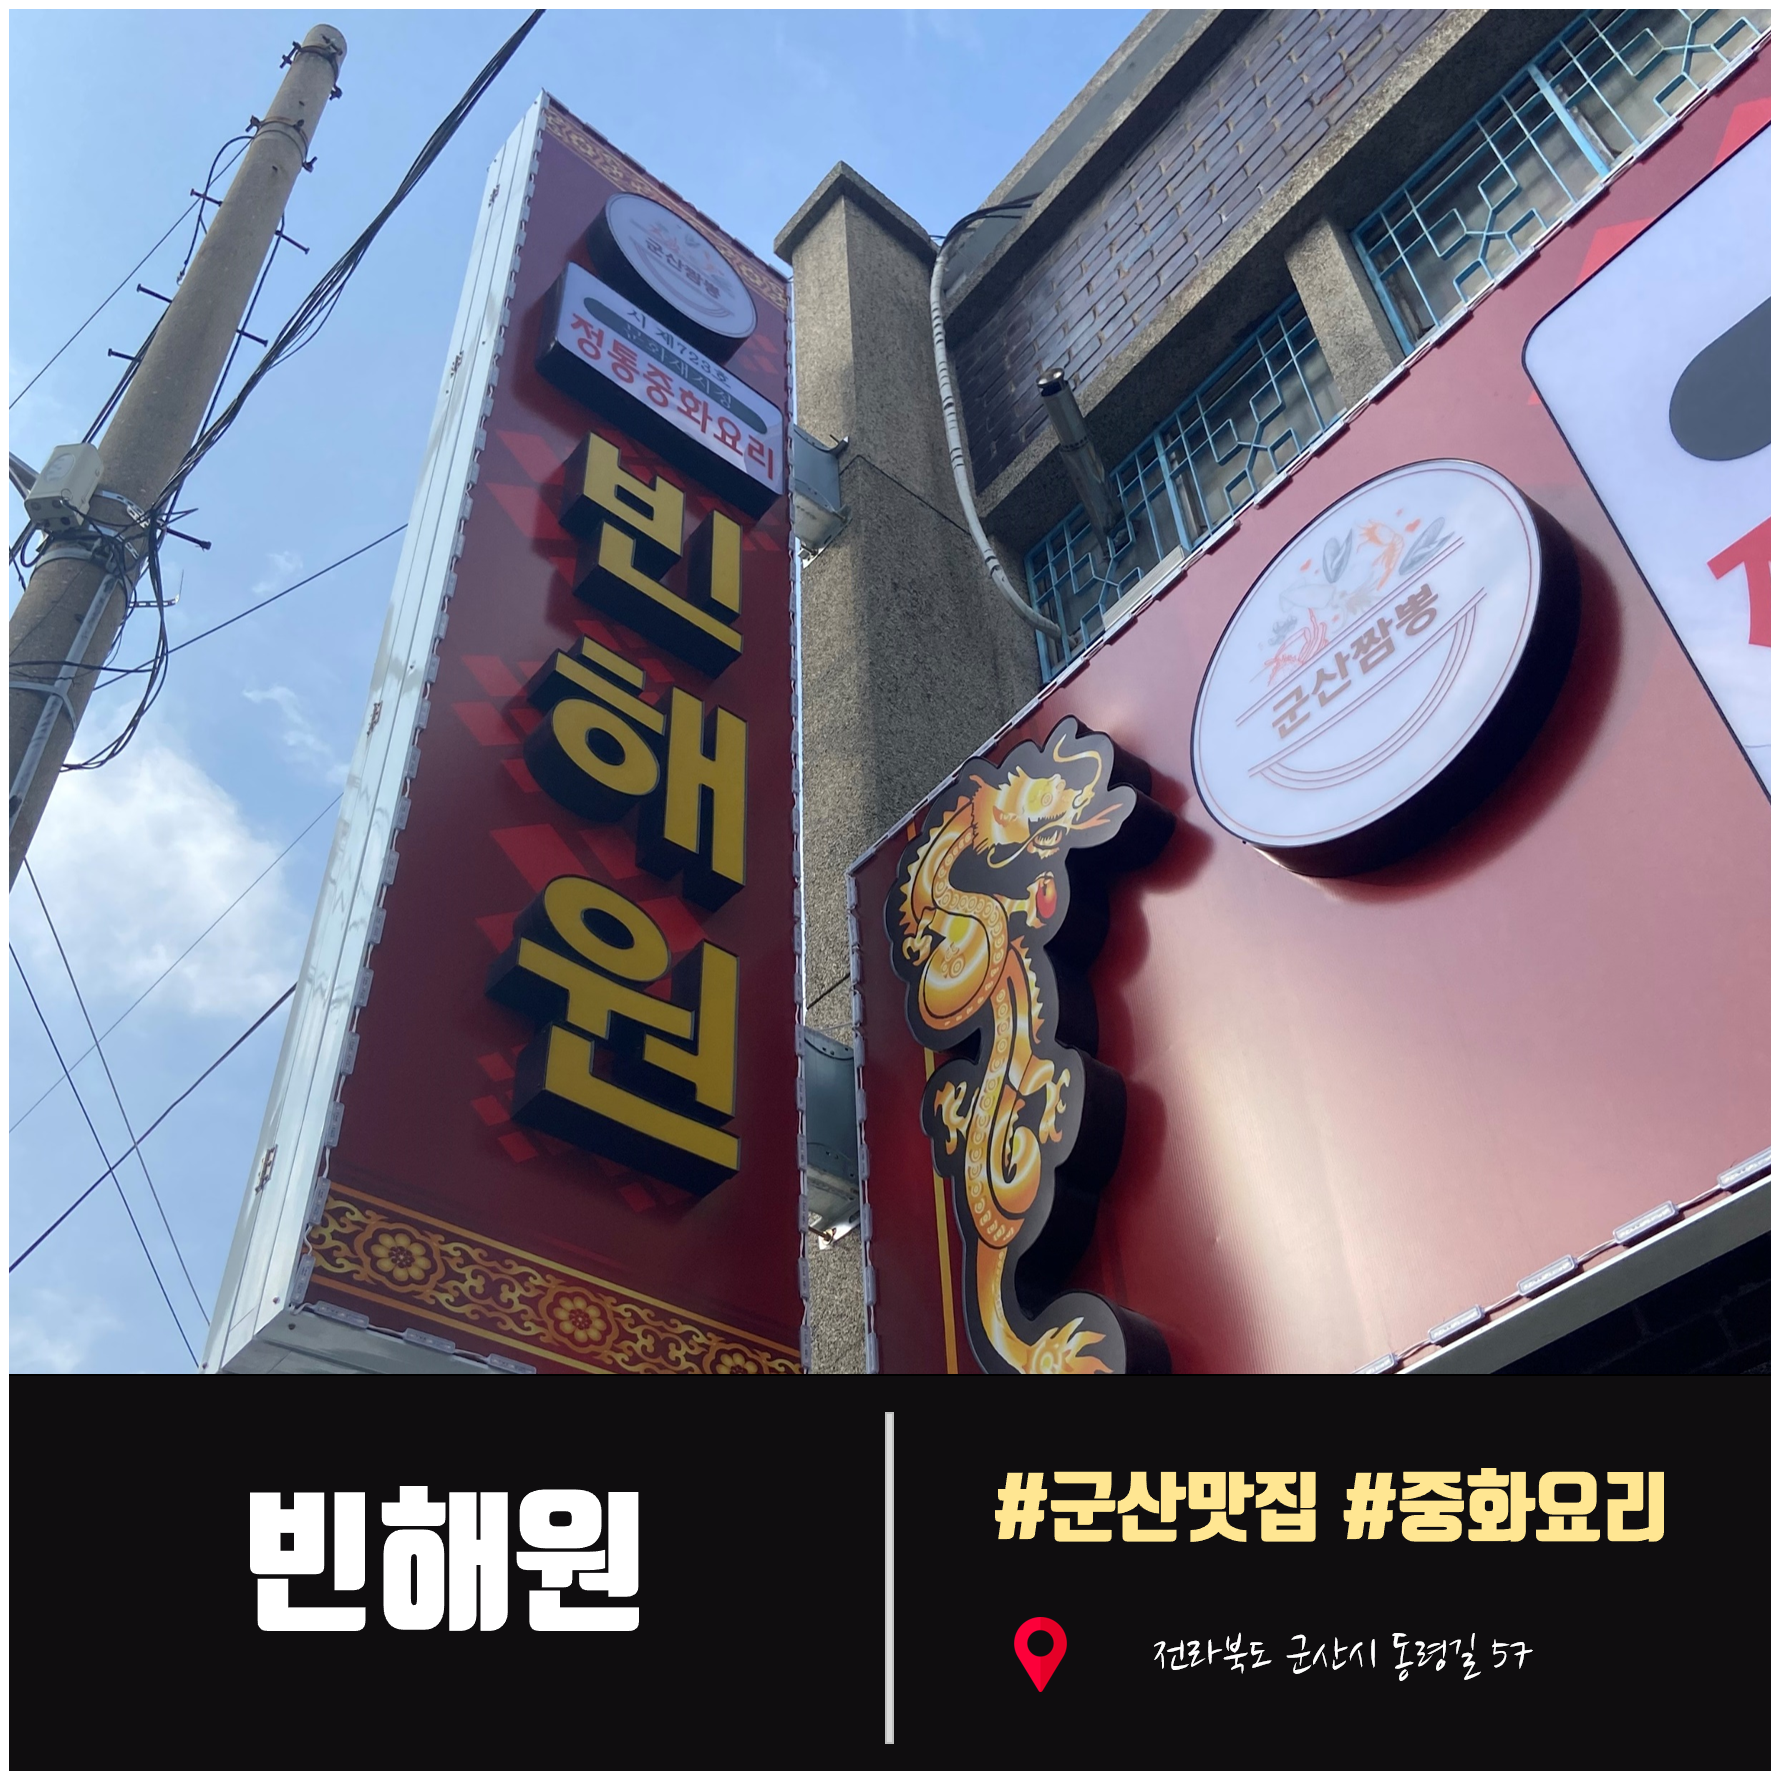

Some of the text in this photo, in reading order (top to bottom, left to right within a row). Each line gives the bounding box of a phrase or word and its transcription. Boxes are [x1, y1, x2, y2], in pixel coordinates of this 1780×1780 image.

[645, 237, 721, 300] 군산짬뽕
[570, 313, 774, 481] 정통중화요리
[624, 323, 732, 409] 문화재지정
[1271, 583, 1439, 739] 군산짬뽕
[517, 433, 747, 1172] 빈해원
